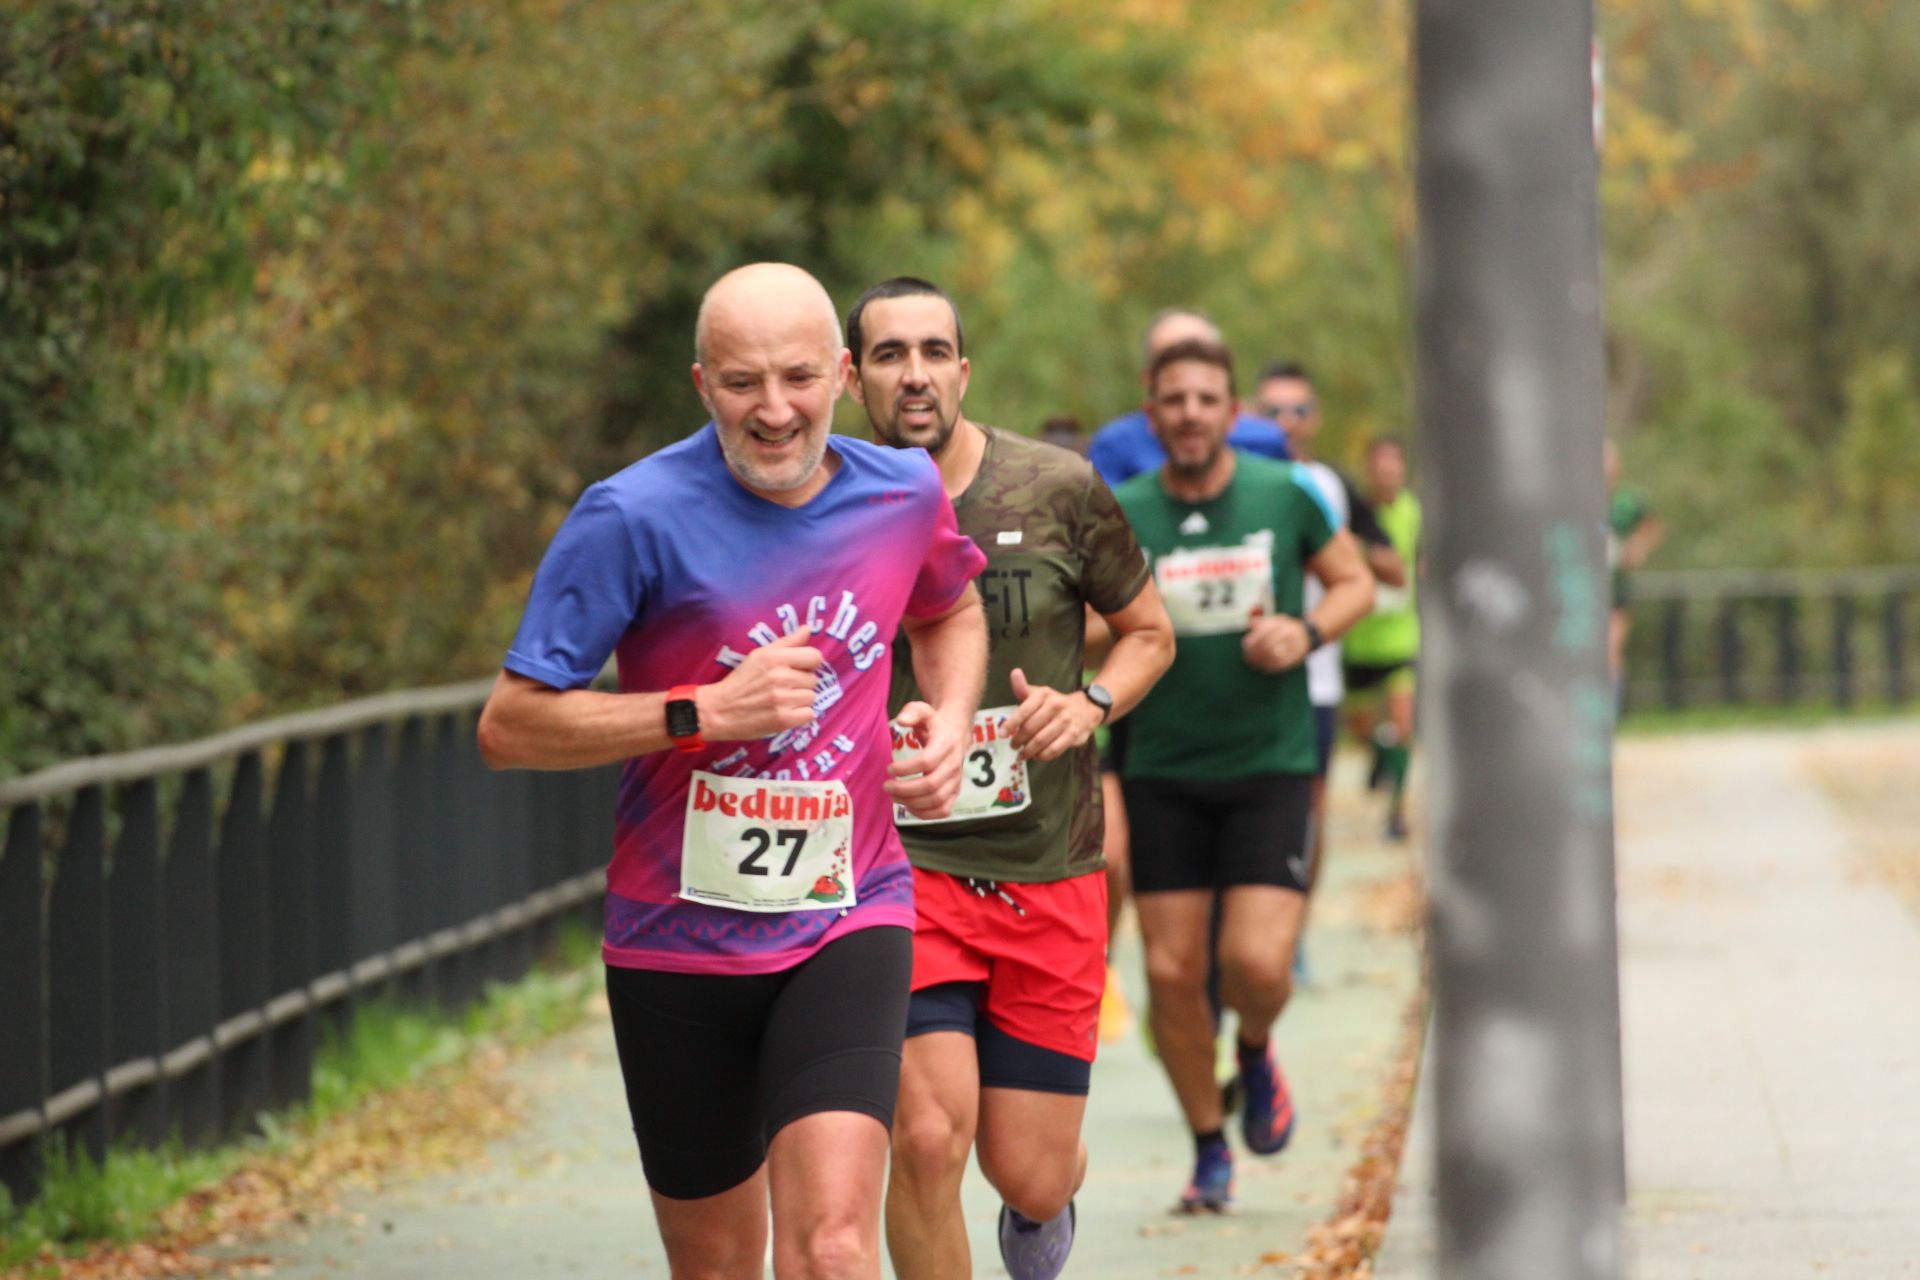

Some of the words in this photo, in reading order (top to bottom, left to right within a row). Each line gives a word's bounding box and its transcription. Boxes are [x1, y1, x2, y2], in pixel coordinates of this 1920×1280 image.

[1196, 581, 1236, 611] 22
[693, 779, 849, 820] bedunia
[738, 827, 808, 877] 27
